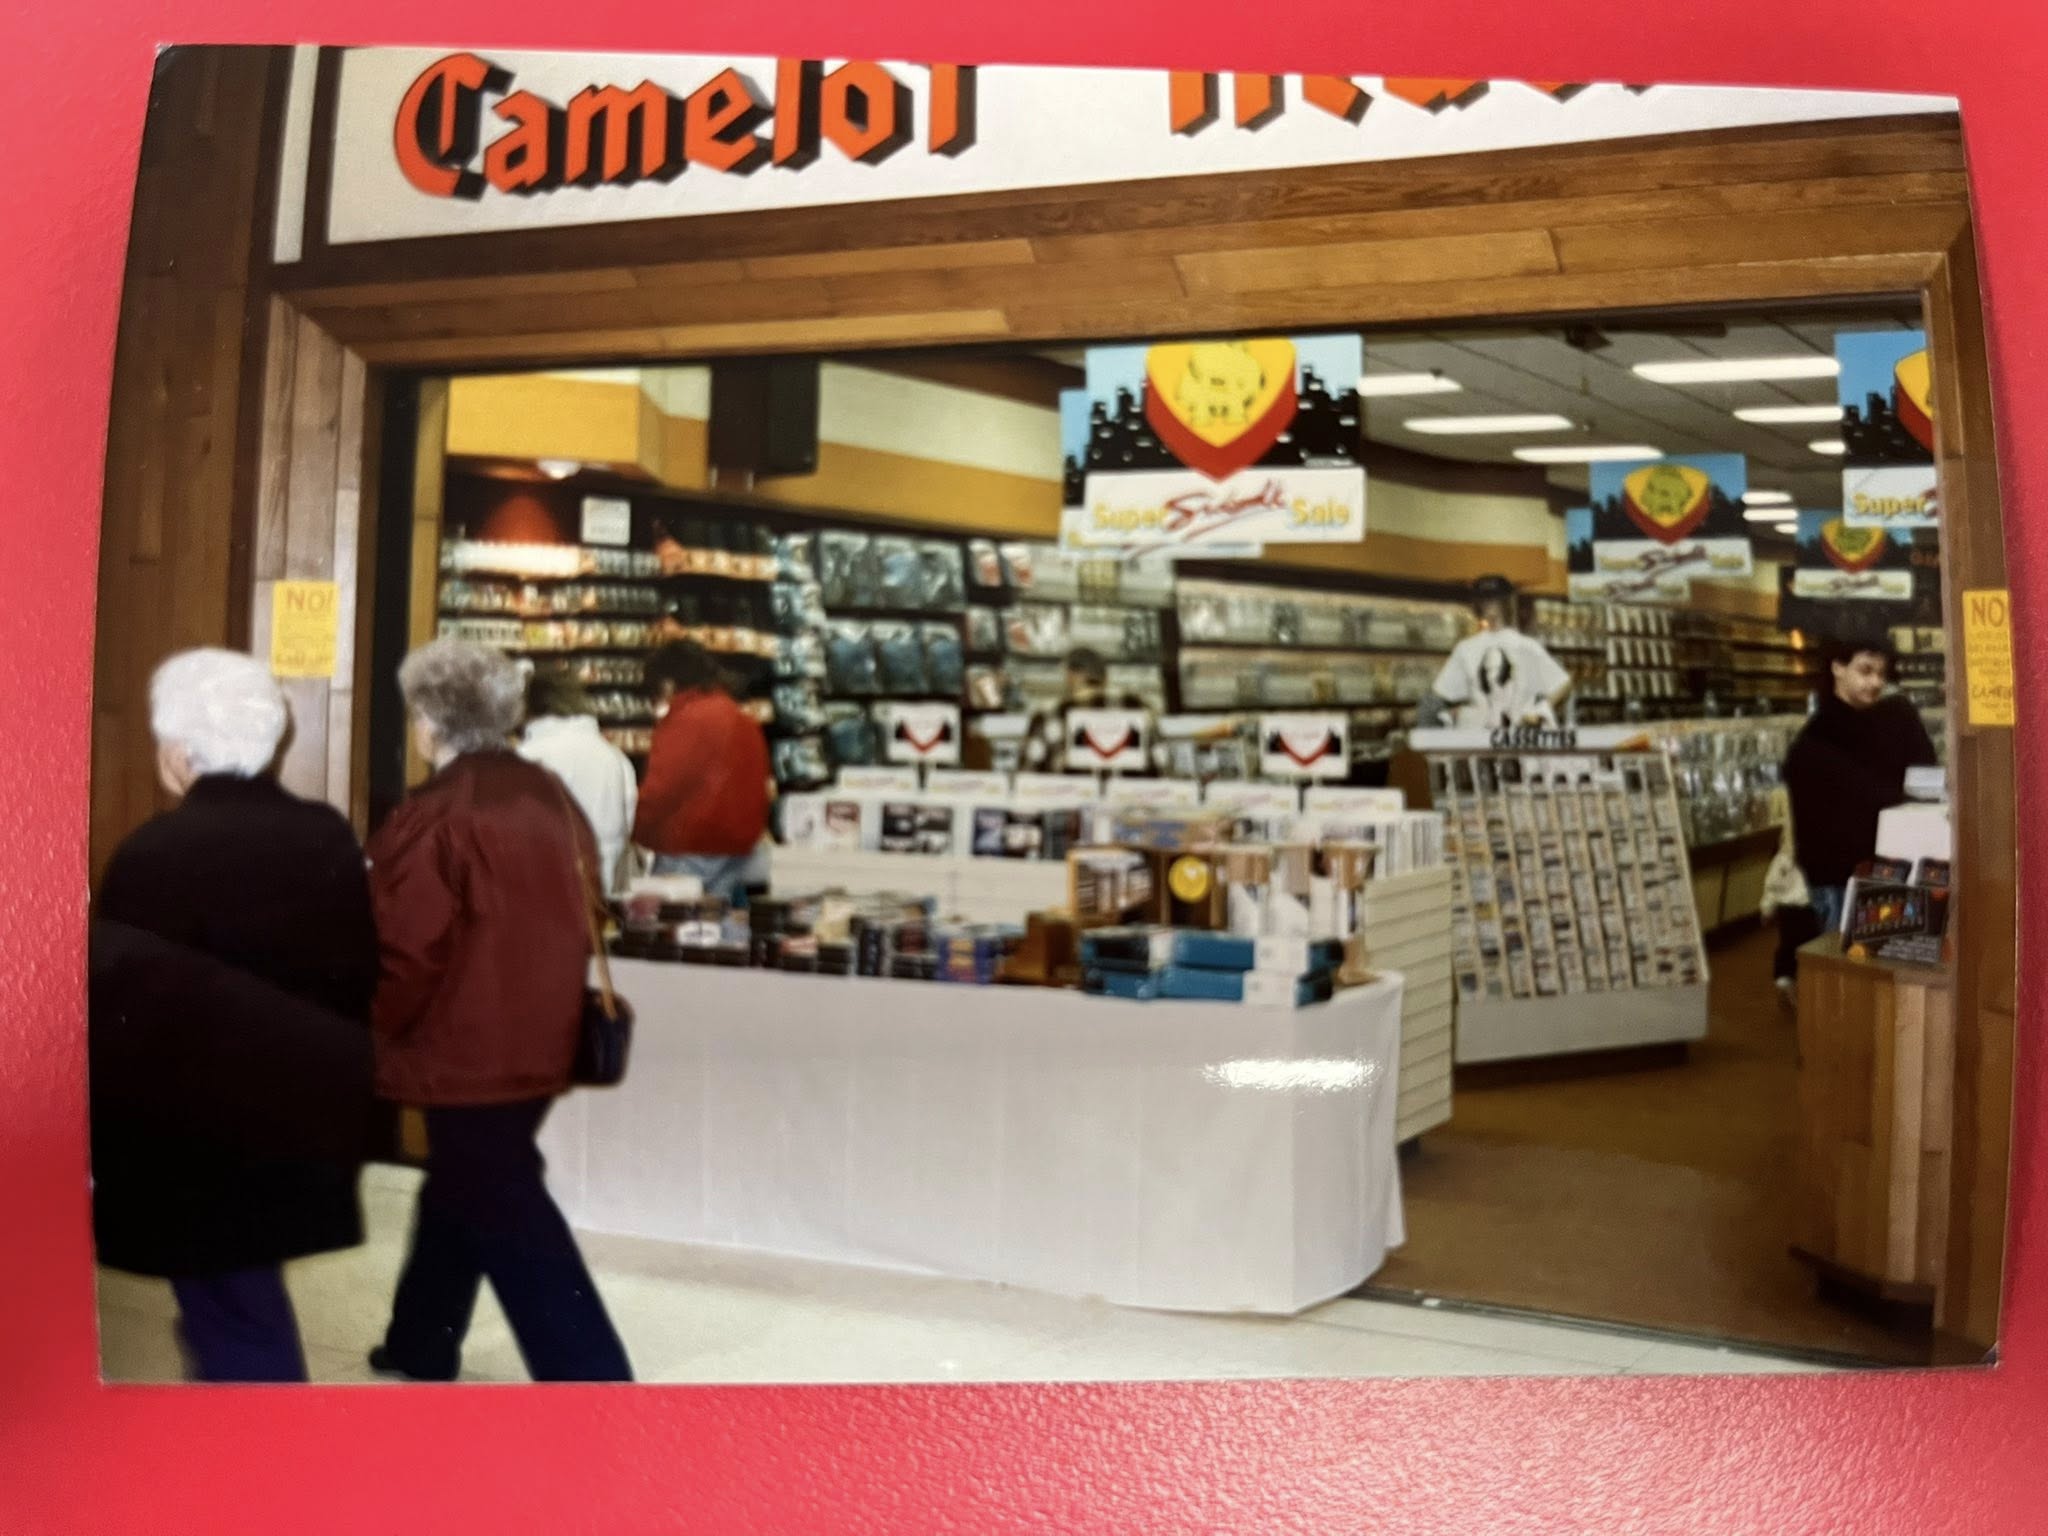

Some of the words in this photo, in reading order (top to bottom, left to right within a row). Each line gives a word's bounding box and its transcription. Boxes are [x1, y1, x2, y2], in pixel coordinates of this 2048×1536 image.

[394, 52, 977, 200] Camelot
[1093, 501, 1167, 530] Super
[1291, 498, 1351, 526] Sale
[1854, 492, 1926, 520] Super
[1490, 728, 1577, 748] CASSETTES
